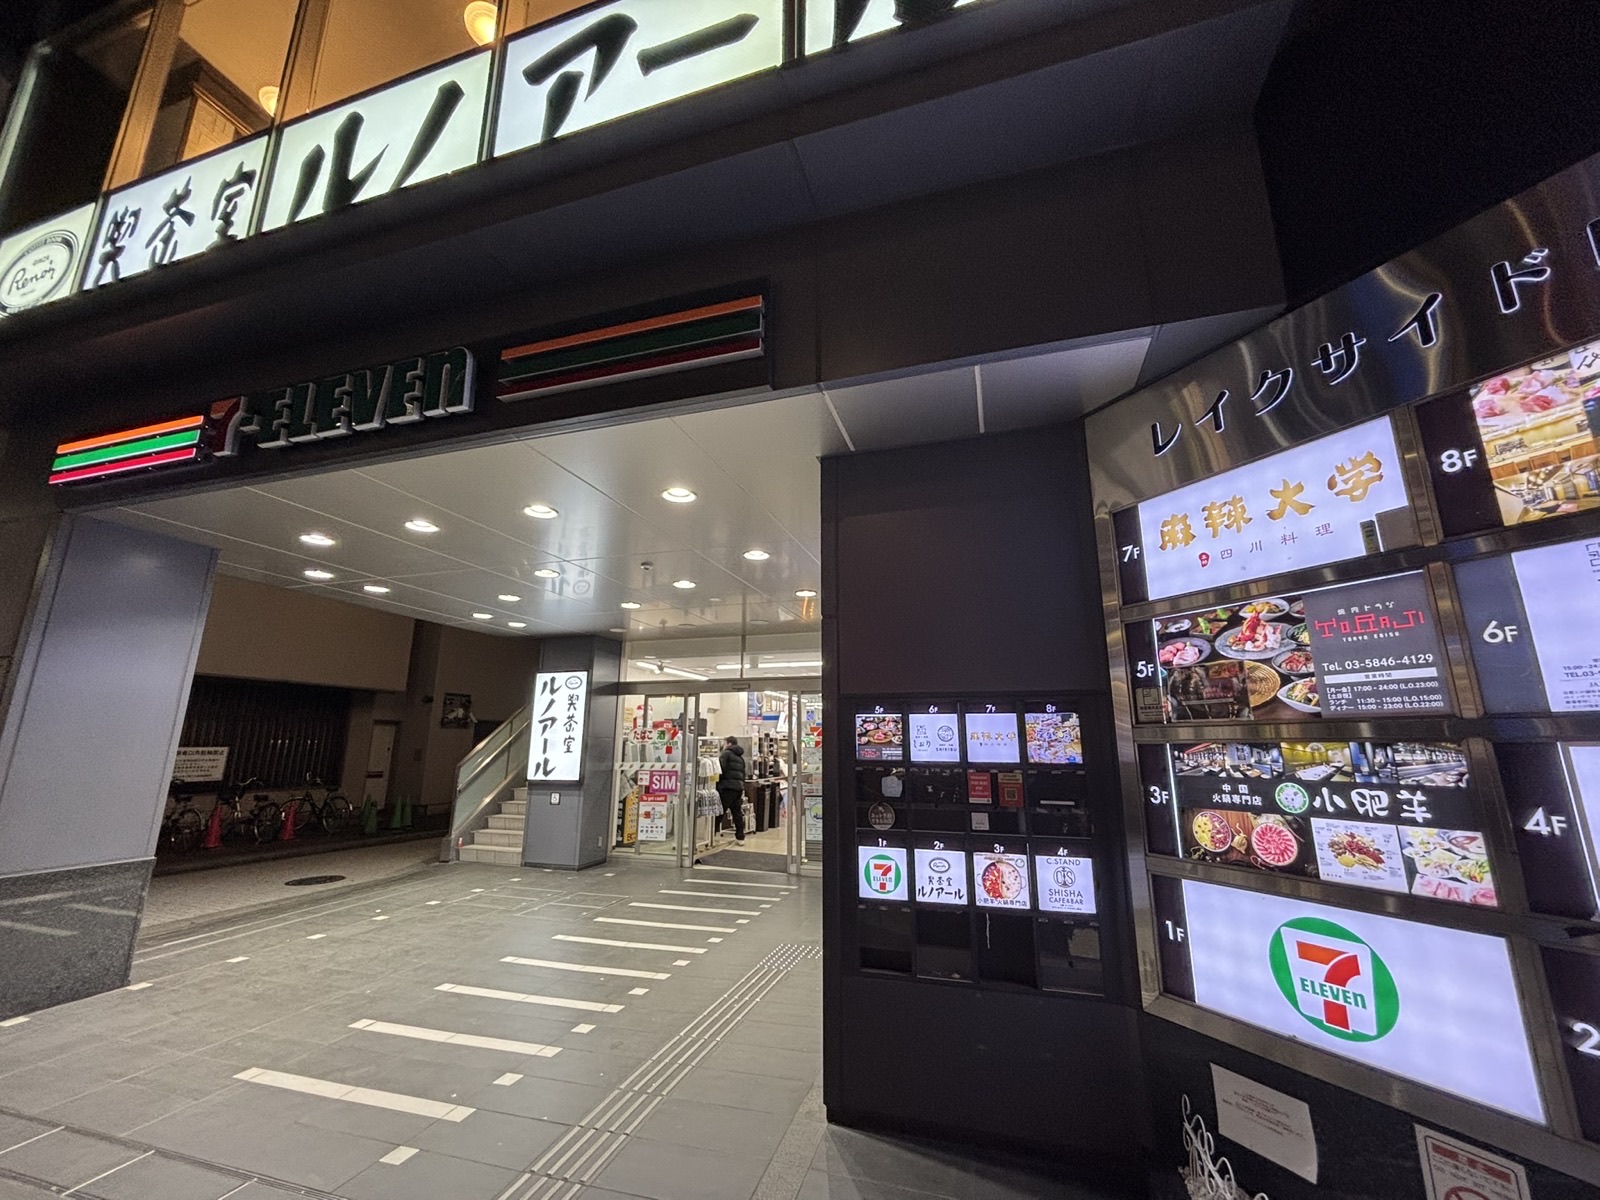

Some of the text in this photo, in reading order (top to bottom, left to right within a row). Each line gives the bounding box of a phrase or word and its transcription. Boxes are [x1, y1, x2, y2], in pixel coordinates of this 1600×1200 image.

[1150, 216, 1600, 457] レイクサイド
[1440, 447, 1478, 473] 8F
[1159, 450, 1385, 552] 麻辣大学
[1220, 522, 1335, 560] 四川料理
[1122, 544, 1141, 563] 7F
[1314, 610, 1425, 638] TORAJI
[1482, 619, 1519, 644] 6F
[1135, 661, 1155, 678] 5F
[1322, 653, 1434, 672] Tel. 03-5846-4129
[986, 704, 996, 713] 7F
[1046, 704, 1056, 713] 8F
[533, 676, 563, 778] ルノアール
[563, 693, 580, 754] 喫茶室
[633, 729, 653, 741] たばこ
[656, 729, 666, 741] 酒
[652, 775, 677, 790] SIM
[1150, 786, 1169, 804] 3F
[1212, 794, 1263, 806] 火鍋専門店
[1522, 806, 1568, 837] 4F
[878, 838, 887, 846] 1F
[933, 841, 944, 850] 2F
[993, 843, 1005, 853] 3F
[1057, 847, 1068, 856] 4F
[917, 885, 965, 901] ルノアール
[1048, 888, 1083, 898] SHISHA
[1165, 920, 1185, 942] 1F
